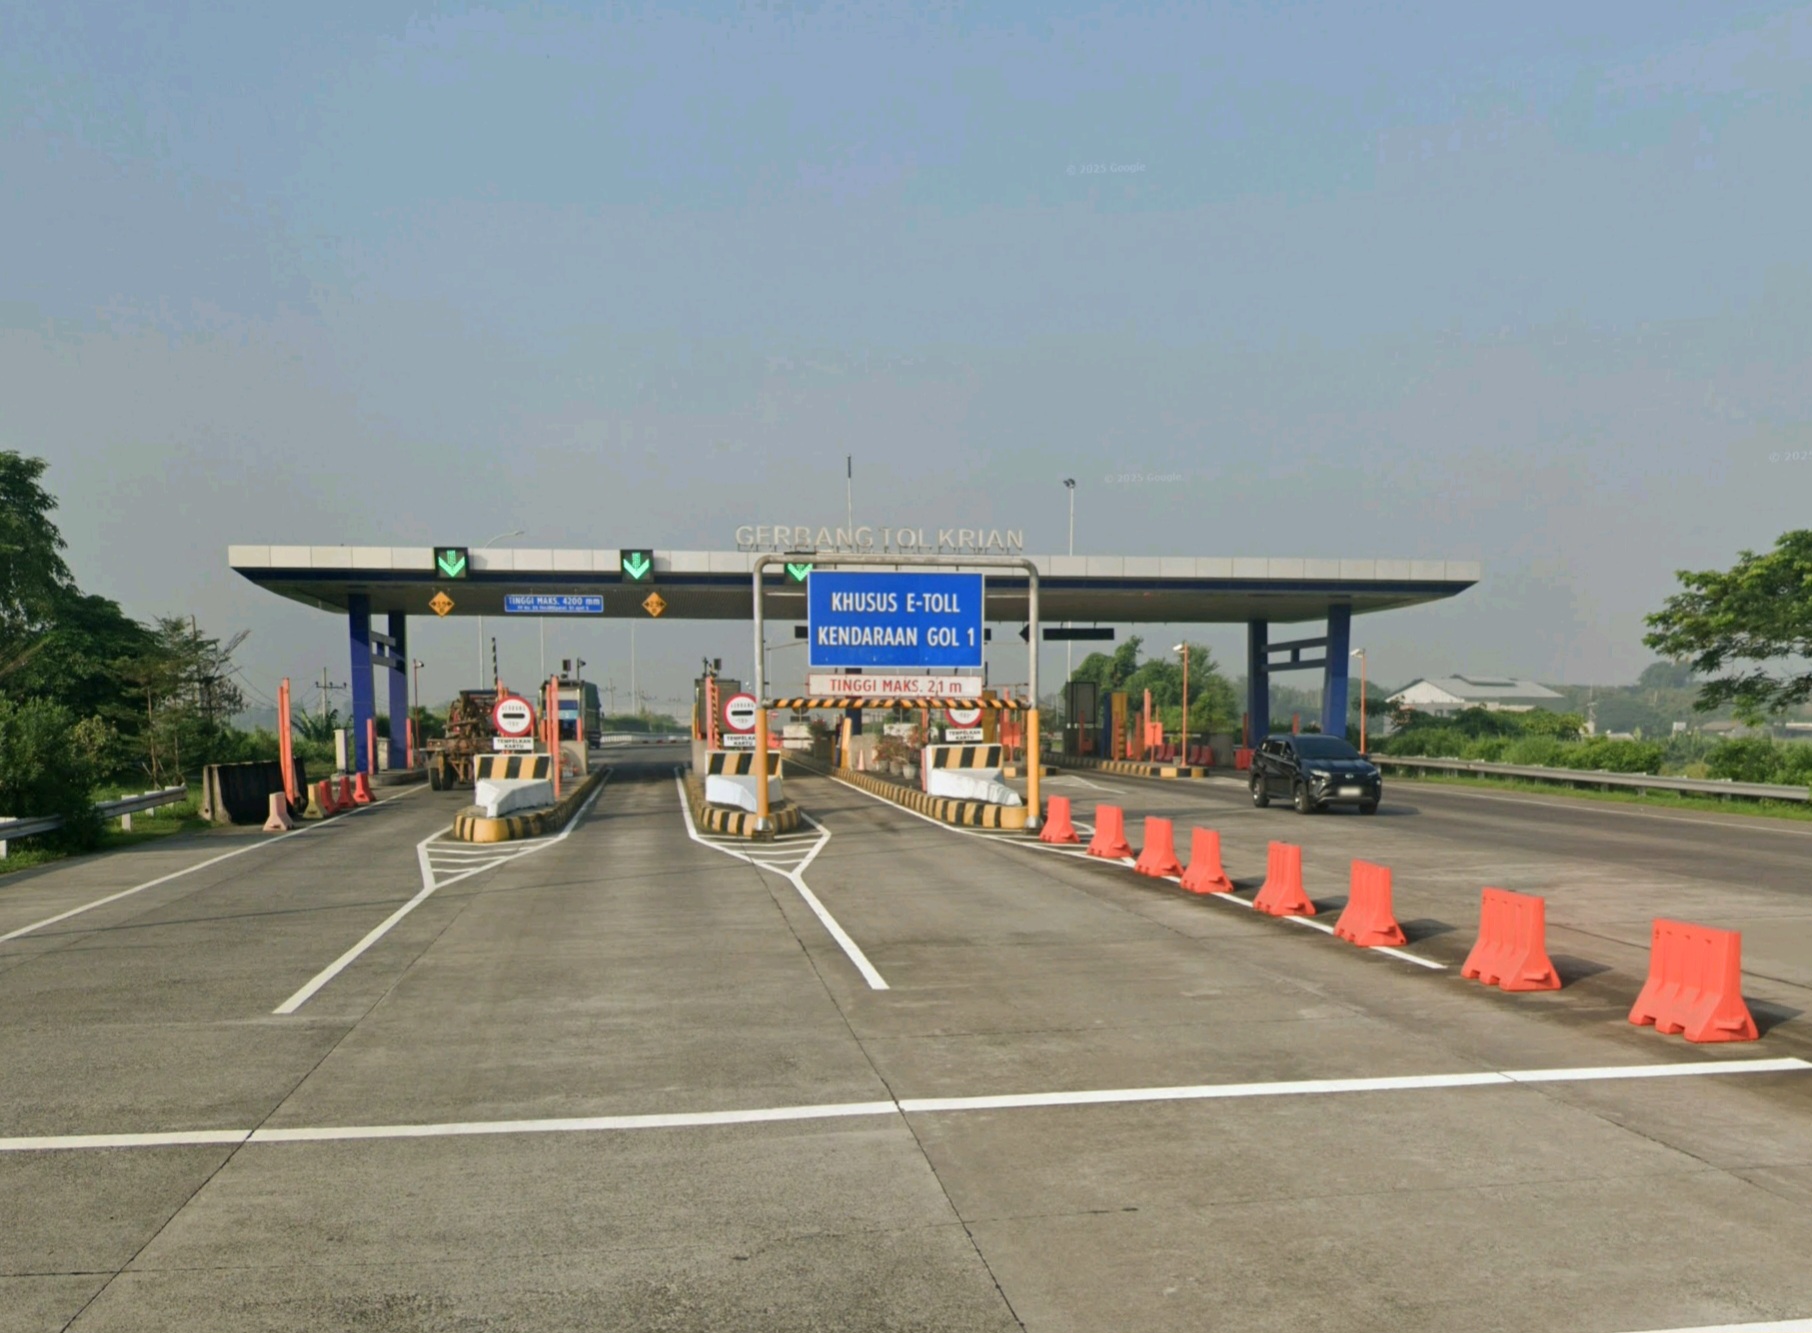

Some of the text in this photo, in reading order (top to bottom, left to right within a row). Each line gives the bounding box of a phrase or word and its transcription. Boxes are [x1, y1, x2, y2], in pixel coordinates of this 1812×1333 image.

[735, 525, 1023, 549] GERBANG TOL KRIAN
[508, 596, 601, 606] TINGGI MAKS. 4200 mm
[831, 592, 961, 613] KHUSUS E-TOLL
[818, 626, 975, 647] KENDARAAN GOL 1
[829, 679, 877, 692] TINGGI
[882, 679, 923, 693] MAKS.
[949, 682, 962, 694] m
